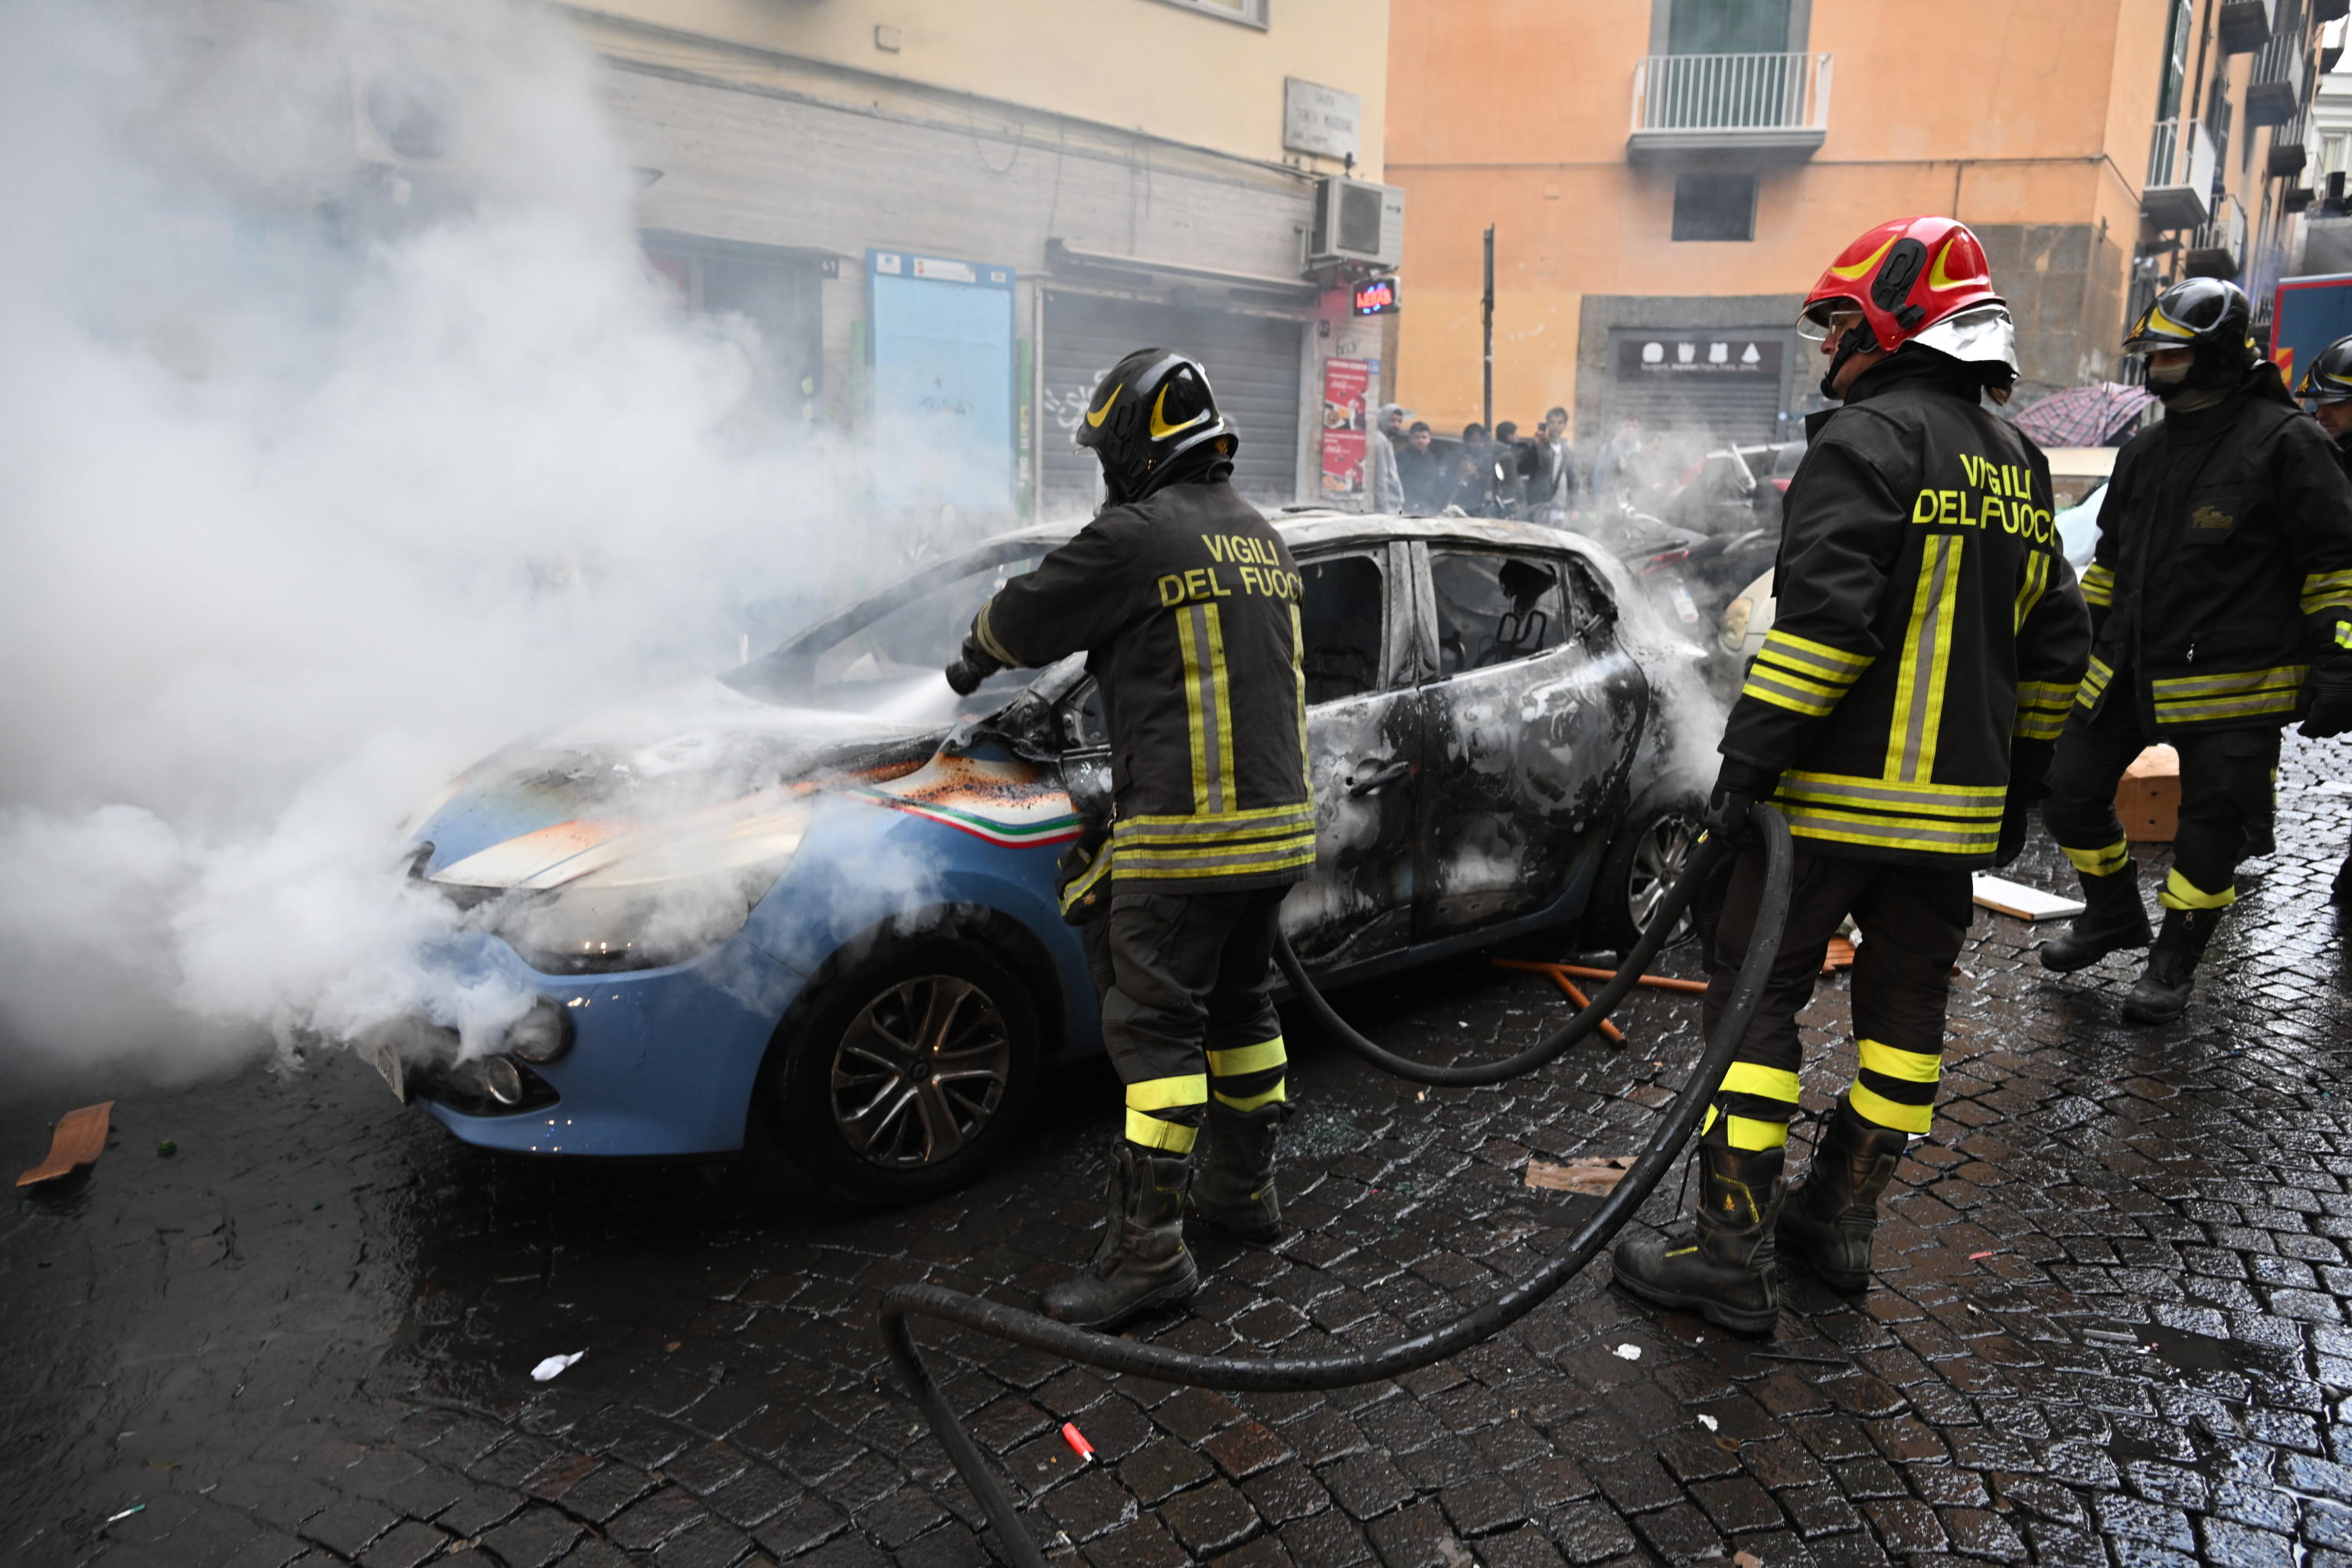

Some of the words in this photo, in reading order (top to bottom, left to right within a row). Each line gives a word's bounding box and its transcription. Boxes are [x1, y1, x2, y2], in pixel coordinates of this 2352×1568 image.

[1959, 453, 2032, 501] VIGILI
[1913, 488, 1977, 525] DEL
[1201, 534, 1280, 567] VIGILI
[1158, 567, 1231, 607] DEL
